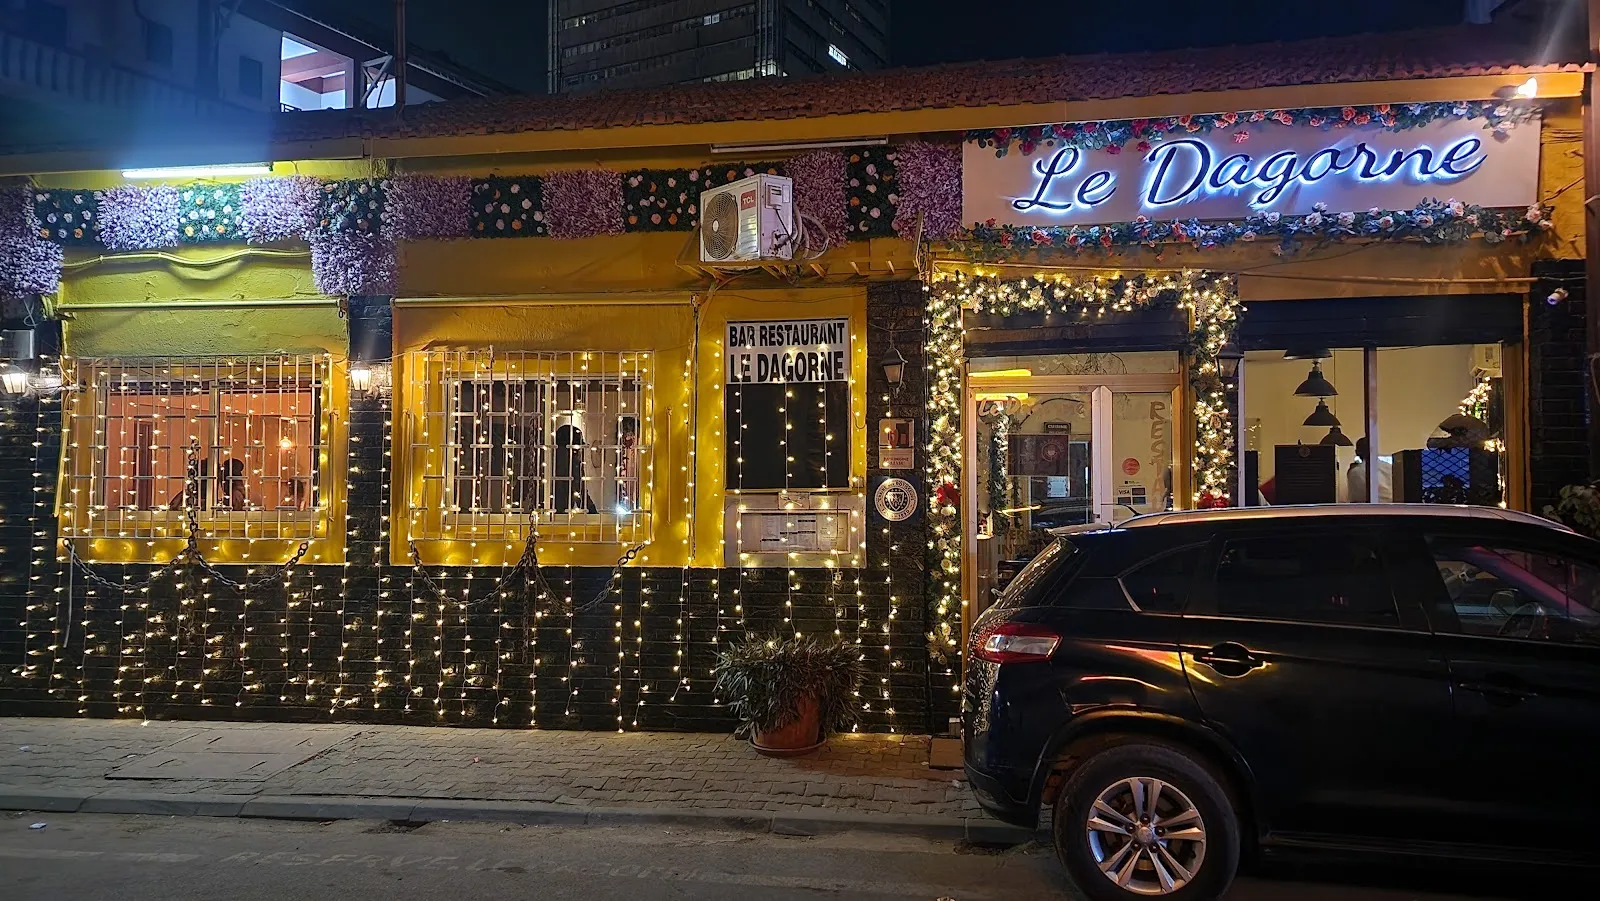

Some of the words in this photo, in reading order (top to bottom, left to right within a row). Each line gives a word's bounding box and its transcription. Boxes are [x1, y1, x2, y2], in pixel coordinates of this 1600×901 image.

[1012, 147, 1117, 210] Le
[1147, 135, 1487, 207] Dagorne
[742, 197, 755, 205] TCL
[729, 326, 756, 347] BAR
[759, 323, 845, 347] RESTAURANT
[730, 353, 752, 382] LE
[757, 351, 844, 382] DAGORNE
